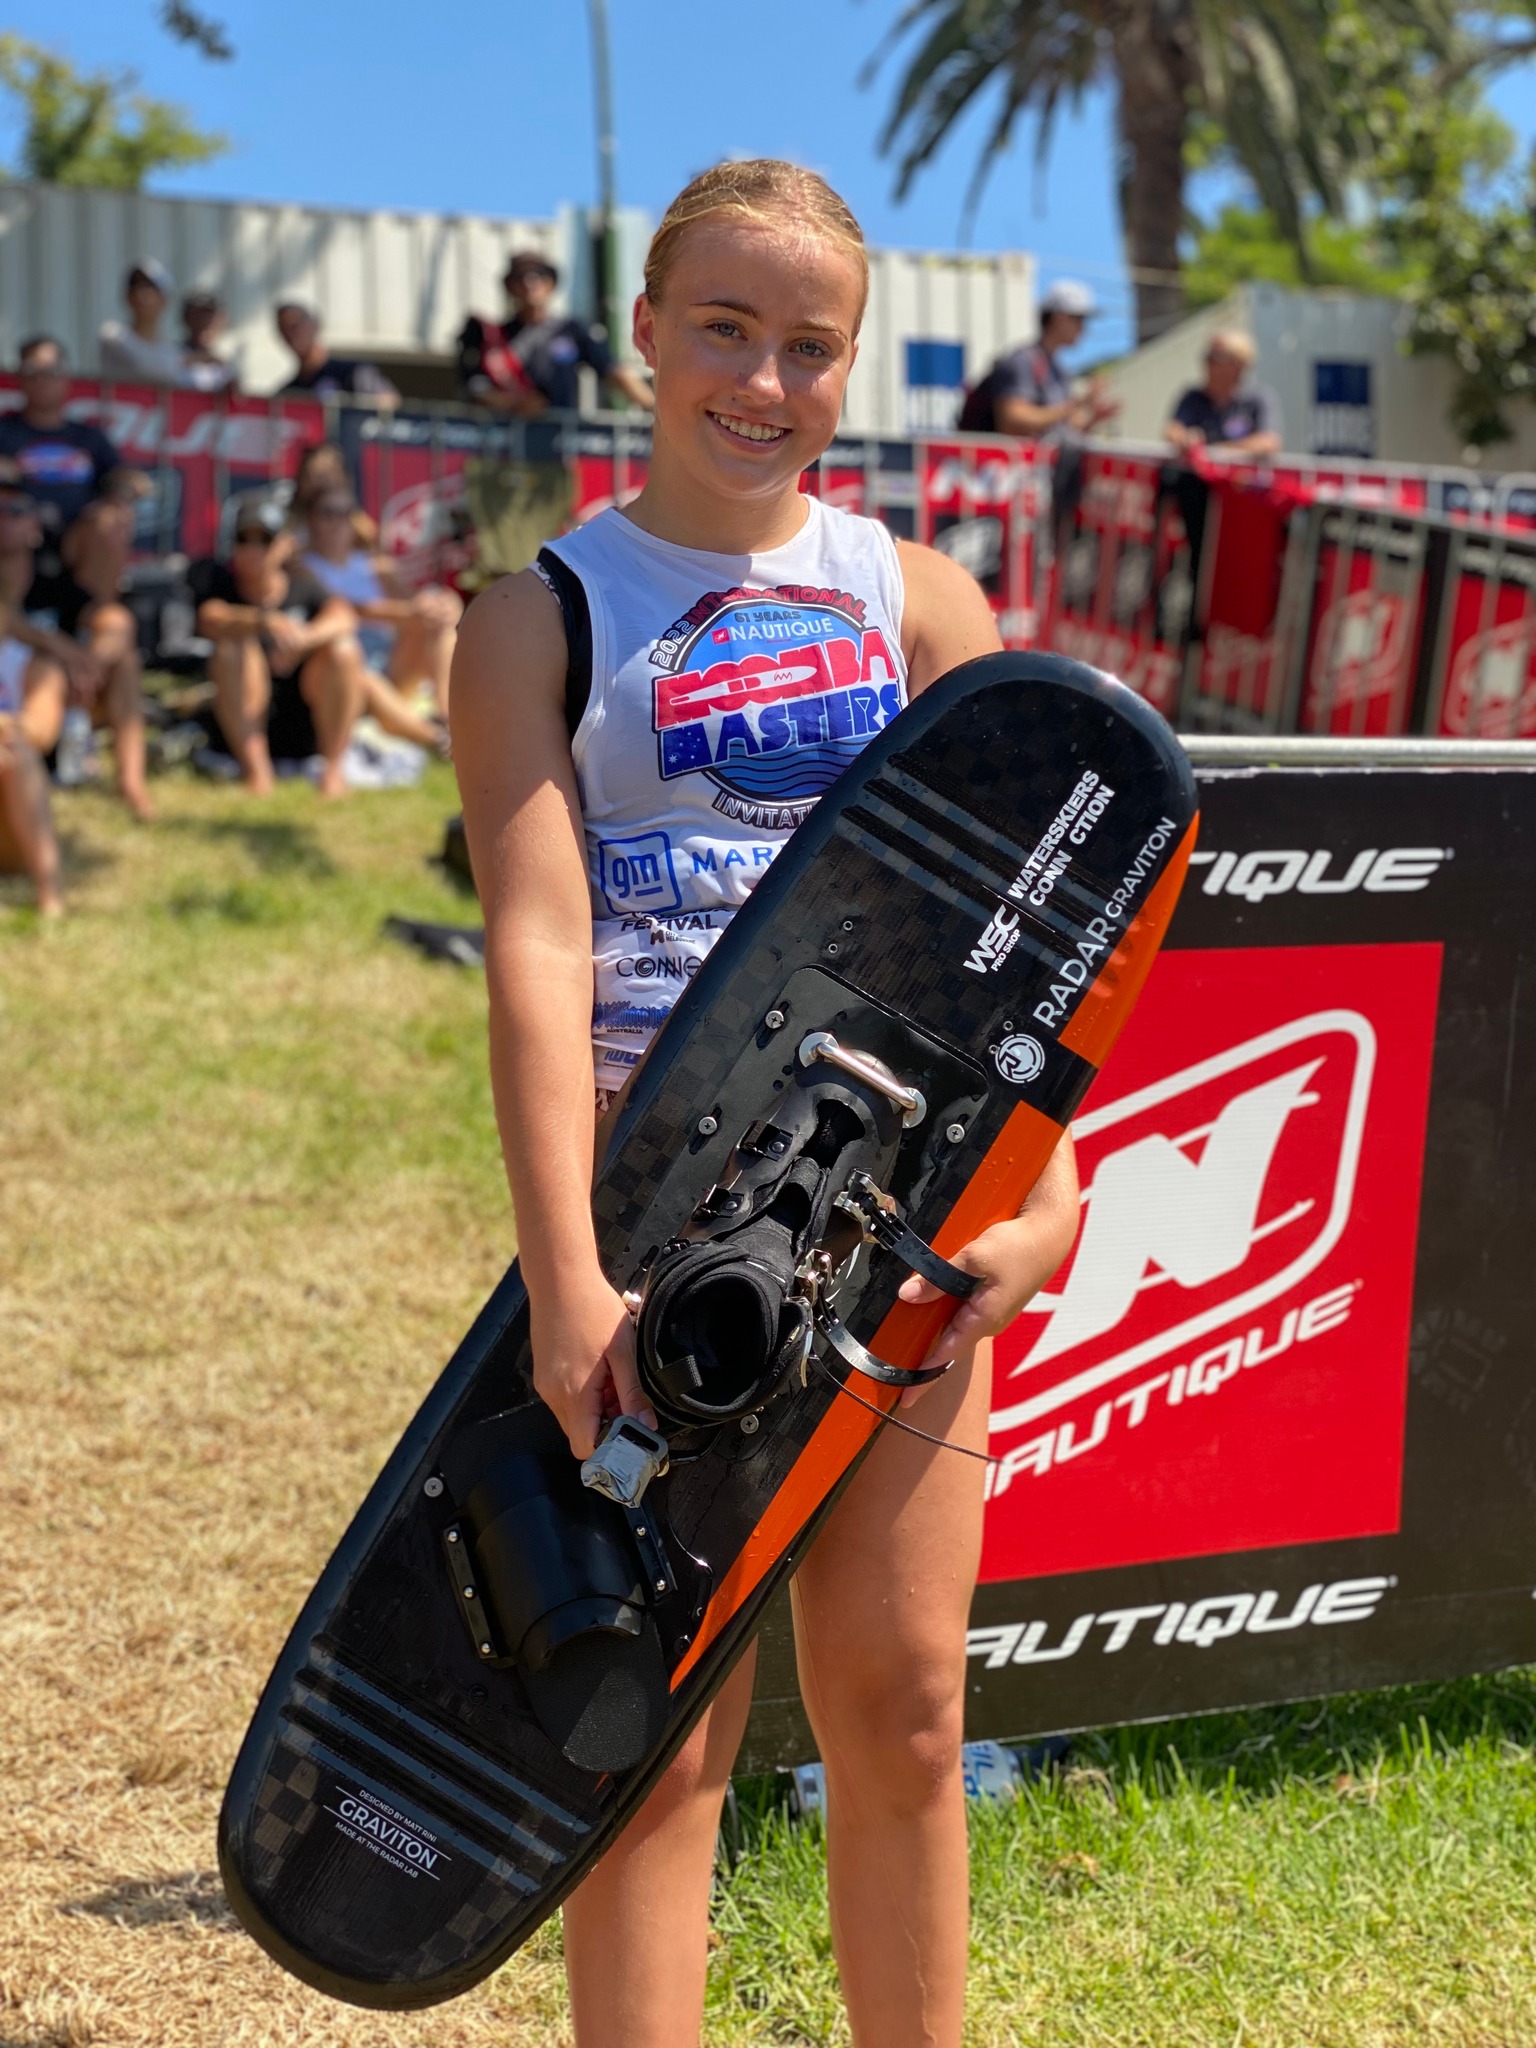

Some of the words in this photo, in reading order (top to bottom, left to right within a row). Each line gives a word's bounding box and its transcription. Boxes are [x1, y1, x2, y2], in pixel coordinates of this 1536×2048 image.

[731, 618, 834, 641] NAUTIQUE
[755, 611, 802, 622] YEARS
[652, 620, 696, 667] 2022
[656, 629, 898, 730] MOOMBA
[661, 683, 901, 778] MASTERS
[716, 793, 813, 828] INVITAT
[1007, 770, 1100, 900] WATERSKIERS
[692, 846, 784, 874] MAR
[963, 904, 1020, 974] WSC
[1033, 916, 1117, 1029] RADAR
[1105, 816, 1178, 919] GRAVITON
[991, 952, 1007, 972] PRO
[1002, 928, 1021, 957] SHOP
[339, 1799, 438, 1869] GRAVITON
[359, 1789, 394, 1815] DESIGNED
[394, 1811, 404, 1821] BY
[404, 1817, 422, 1833] MATT
[335, 1821, 357, 1839] MADE
[356, 1834, 366, 1845] AT
[366, 1840, 380, 1854] THE
[379, 1848, 404, 1869] RADAR
[404, 1864, 418, 1878] LAB
